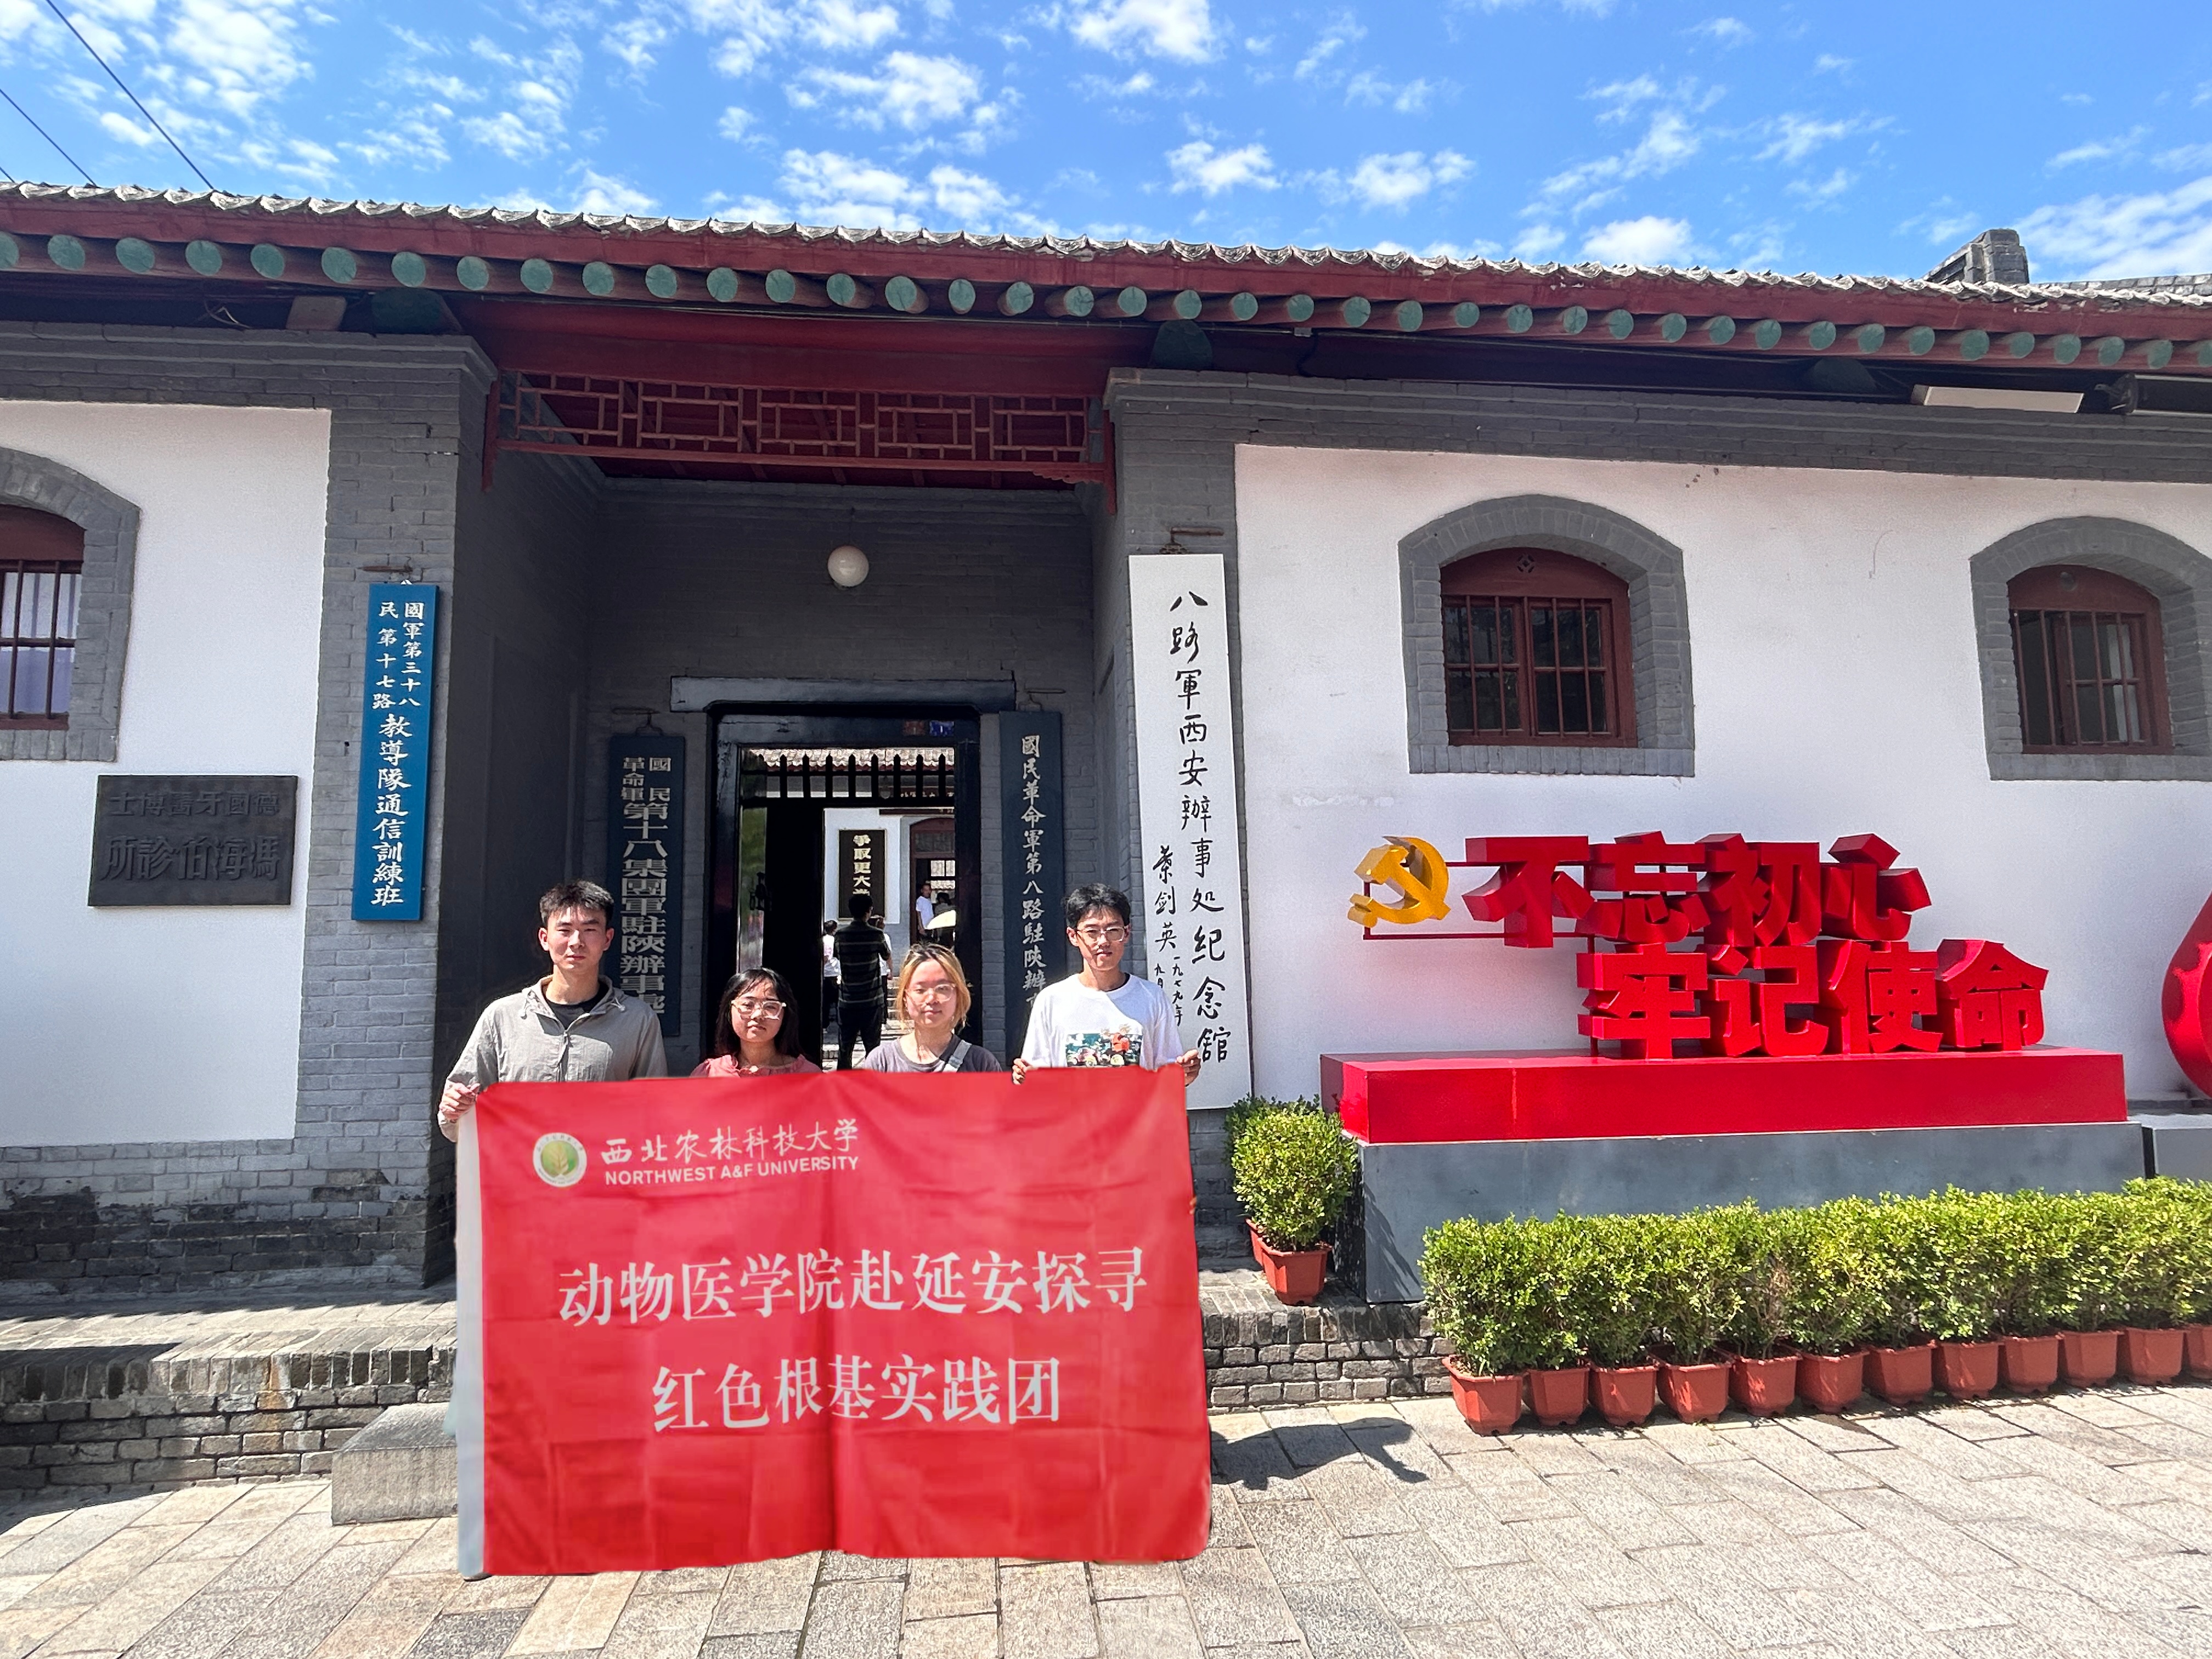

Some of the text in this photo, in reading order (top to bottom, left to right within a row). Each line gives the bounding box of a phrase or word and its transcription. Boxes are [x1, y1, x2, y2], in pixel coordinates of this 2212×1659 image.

[371, 713, 413, 906] 教導隊通信訓練班
[1462, 831, 1933, 948] 不忘初心
[1577, 938, 2049, 1059] 牢记使命
[601, 1118, 859, 1165] 西北农林科技大学
[605, 1166, 715, 1186] NORTHWEST
[720, 1163, 753, 1179] A&F
[758, 1155, 859, 1177] UNIVERSITY
[557, 1245, 1148, 1327] 动物医学院赴延安探寻
[652, 1353, 1060, 1434] 红色根基实践团
